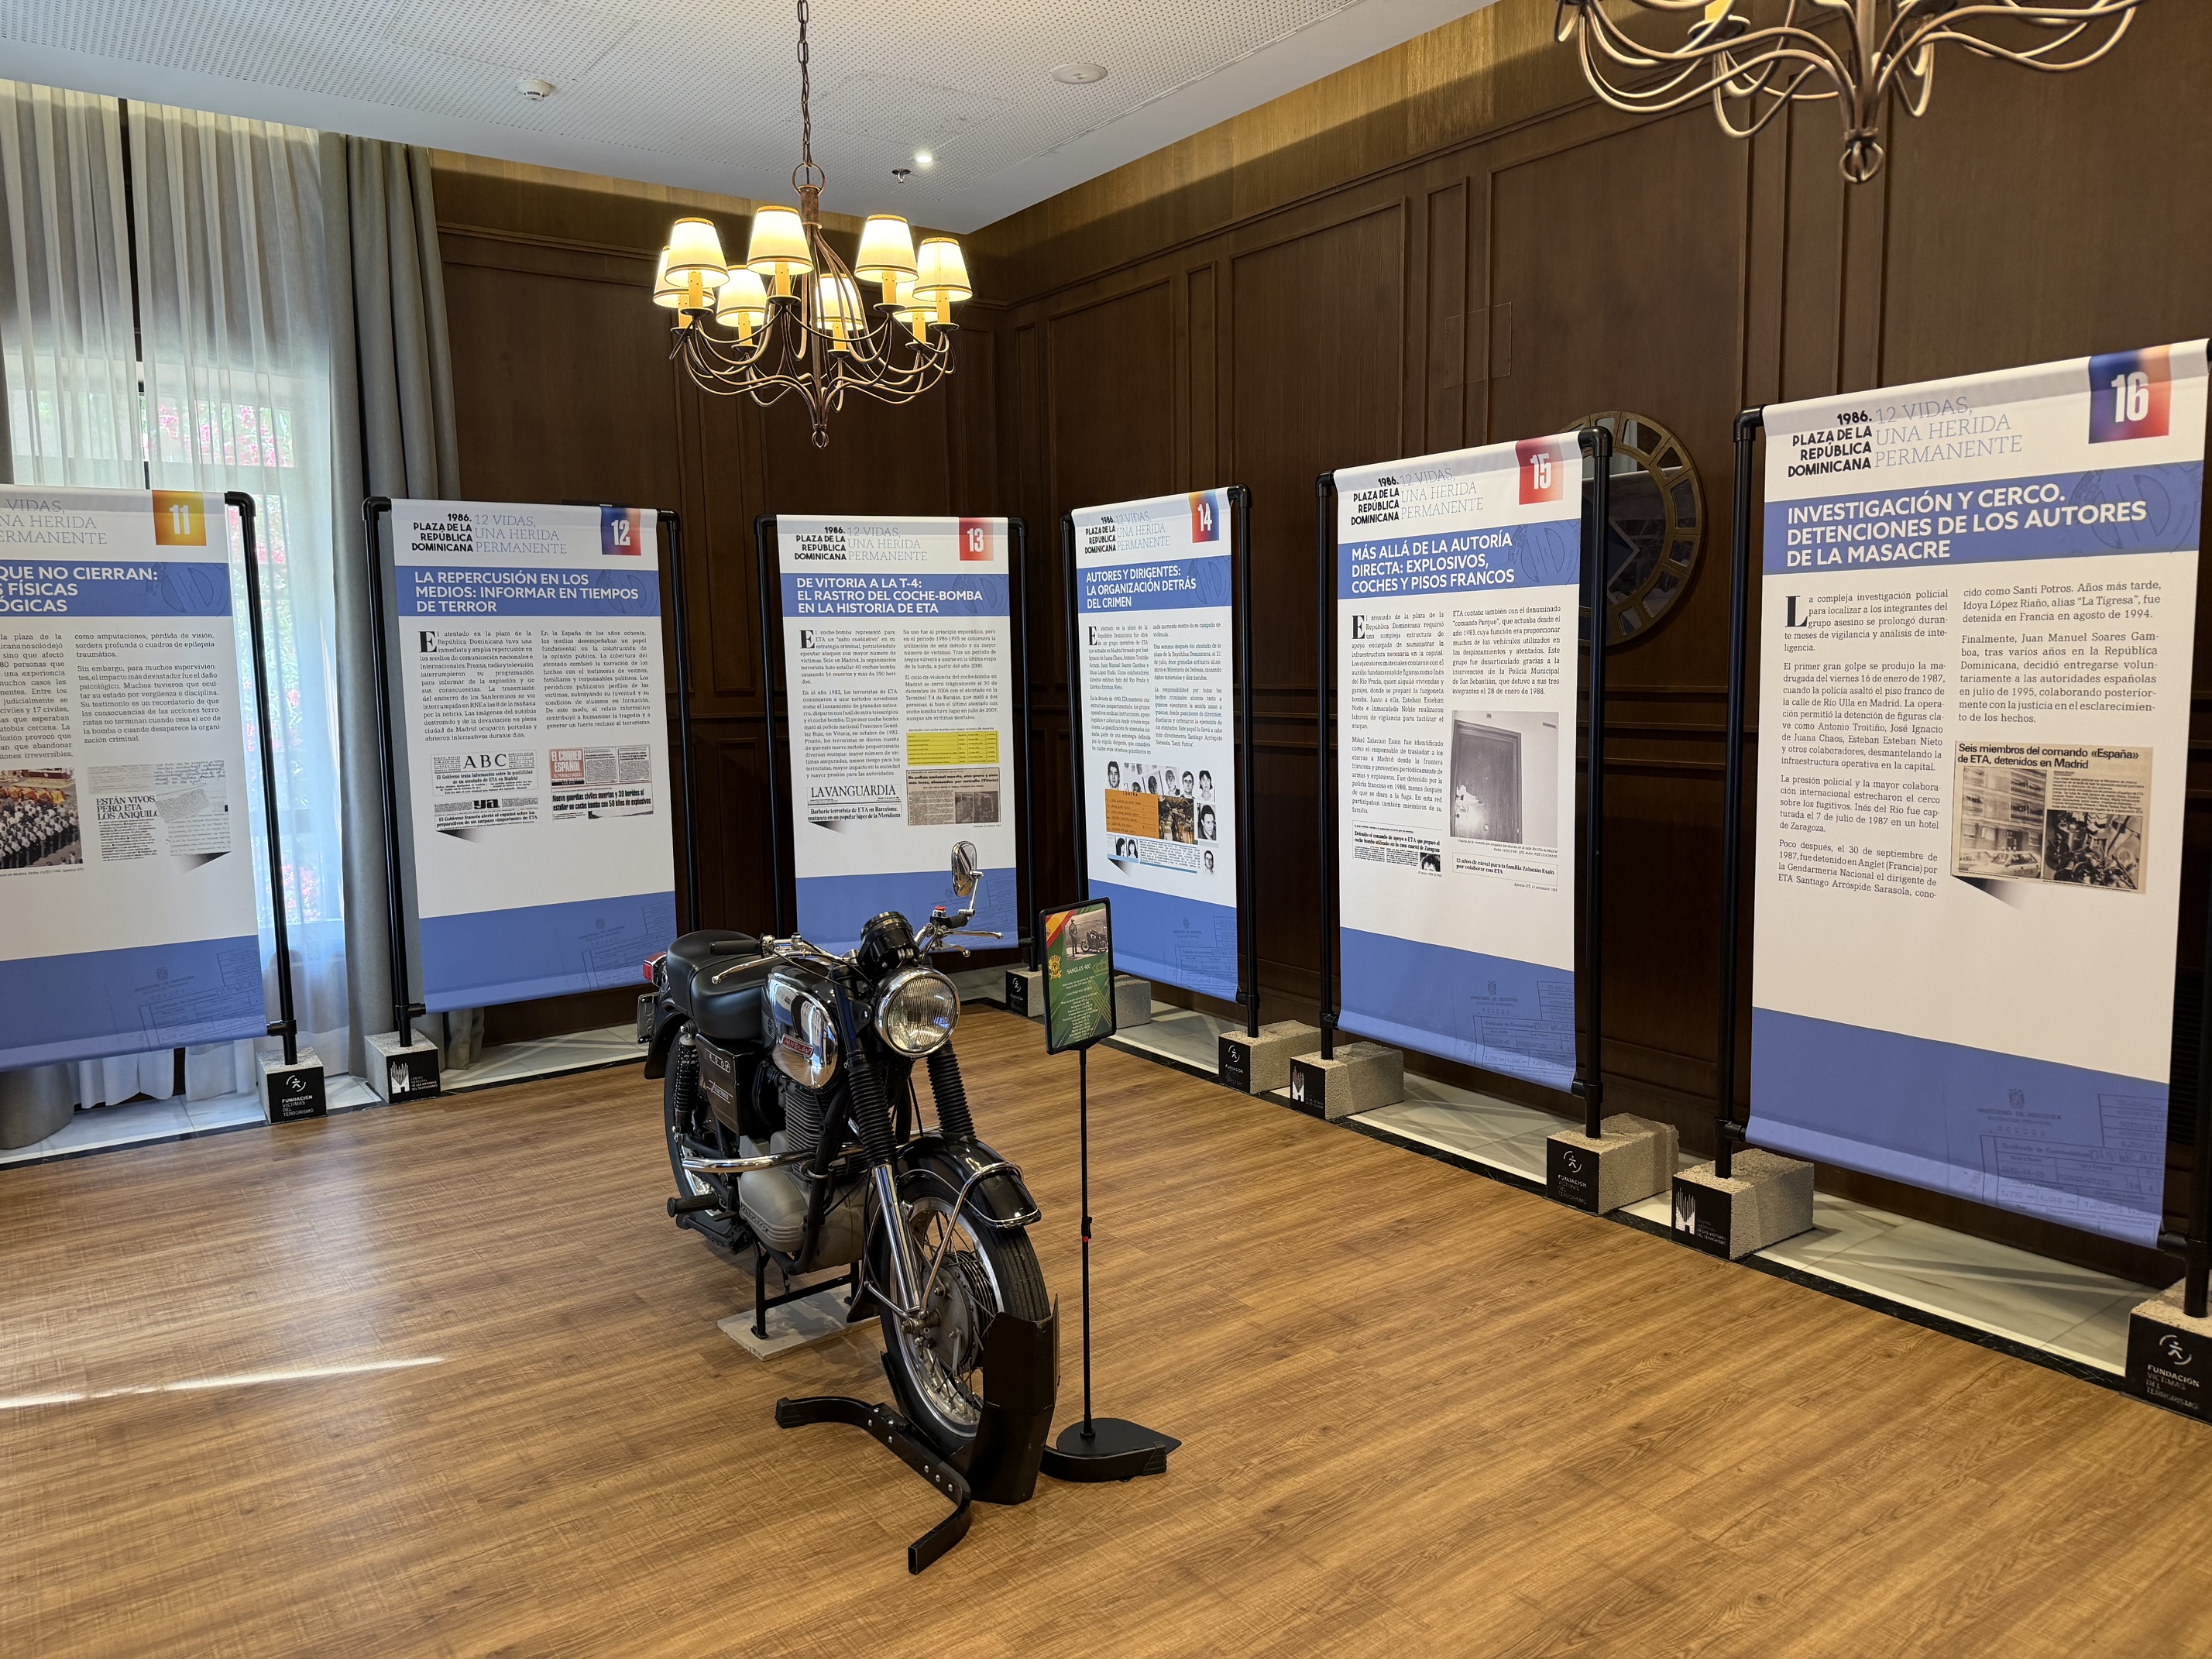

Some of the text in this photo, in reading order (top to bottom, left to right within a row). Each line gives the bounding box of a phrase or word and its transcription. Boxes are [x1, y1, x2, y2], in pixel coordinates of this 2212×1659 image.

[2111, 370, 2149, 424] 16
[1836, 410, 1873, 426] 1986.
[1874, 397, 1973, 426] 12 VIDAS,
[1792, 424, 1873, 447] PLAZA DE LA
[1876, 414, 2011, 447] UNA HERIDA
[1800, 440, 1872, 462] REPÚBLICA
[1875, 434, 2022, 469] PERMANENTE
[1530, 452, 1551, 490] 15
[1788, 457, 1872, 478] DOMINICANA
[1378, 476, 1400, 487] 1986.
[1400, 468, 1456, 487] 12 VIDAS,
[1353, 487, 1400, 503] PLAZA DE LA
[1400, 481, 1477, 503] UNA HERIDA
[6, 500, 65, 514] VIDAS,
[1358, 499, 1400, 514] REPÚBLICA
[1400, 497, 1484, 520] PERMANENTE
[1788, 483, 2066, 524] INVESTIGACIÓN Y CERCO.
[0, 515, 97, 529] NA HERIDA
[169, 504, 191, 535] 11
[475, 514, 536, 528] 12 VIDAS,
[1101, 516, 1115, 524] 1986.
[1197, 503, 1213, 532] 14
[1351, 511, 1400, 526] DOMINICANA
[1788, 501, 2147, 545] DETENCIONES DE LOS AUTORES
[414, 522, 445, 531] PLAZA
[460, 524, 472, 532] LA
[475, 528, 559, 541] UNA HERIDA
[611, 520, 630, 546] 12
[1086, 527, 1102, 536] PLAZA
[0, 530, 108, 544] ERMANENTE
[421, 531, 472, 542] REPÚBLICA
[967, 527, 984, 552] 13
[1089, 534, 1116, 544] REPÚBLICA
[412, 543, 473, 552] DOMINICANA
[476, 542, 567, 555] PERMANENTE
[802, 542, 847, 551] REPÚBLICA
[1085, 544, 1117, 554] DOMINICANA
[1352, 529, 1513, 562] MÁS ALLÁ DE LA AUTORÍA
[1787, 540, 1950, 567] DE LA MASACRE
[1352, 553, 1489, 578] DIRECTA: EXPLOSIVOS,
[0, 566, 157, 581] QUE NO CIERRAN:
[414, 570, 589, 586] LA REPERCUSIÓN EN LOS
[1086, 565, 1181, 583] AUTORES Y DIRIGENTES:
[1352, 568, 1515, 594] COCHES Y PISOS FRANCOS
[9, 579, 77, 596] FÍSICAS
[797, 578, 922, 589] DE VITORIA A LA T-4:
[1087, 575, 1197, 596] LA ORGANIZACIÓN DETRÁS
[416, 586, 639, 599] MEDIOS: INFORMAR EN TIEMPOS
[797, 590, 983, 601] EL RASTRO DEL COCHE-BOMBA
[417, 601, 497, 613] DE TERROR
[798, 603, 939, 613] EN LA HISTORIA DE ETA
[1087, 596, 1132, 609] DEL CRIMEN
[1963, 599, 1988, 611] Idoya
[1990, 599, 2018, 610] López
[2020, 599, 2049, 609] Riaño,
[2051, 597, 2075, 606] alias
[2143, 594, 2161, 604] fue
[1959, 744, 1977, 753] Seis
[1980, 744, 2024, 755] miembros
[2027, 746, 2040, 756] del
[2042, 747, 2088, 757] comando
[1958, 754, 2088, 769] de ETA, detenidos en Madrid
[811, 785, 895, 798] LA VANGUARDIA
[96, 796, 125, 805] ESTÁN
[1067, 966, 1084, 974] SANGLAS
